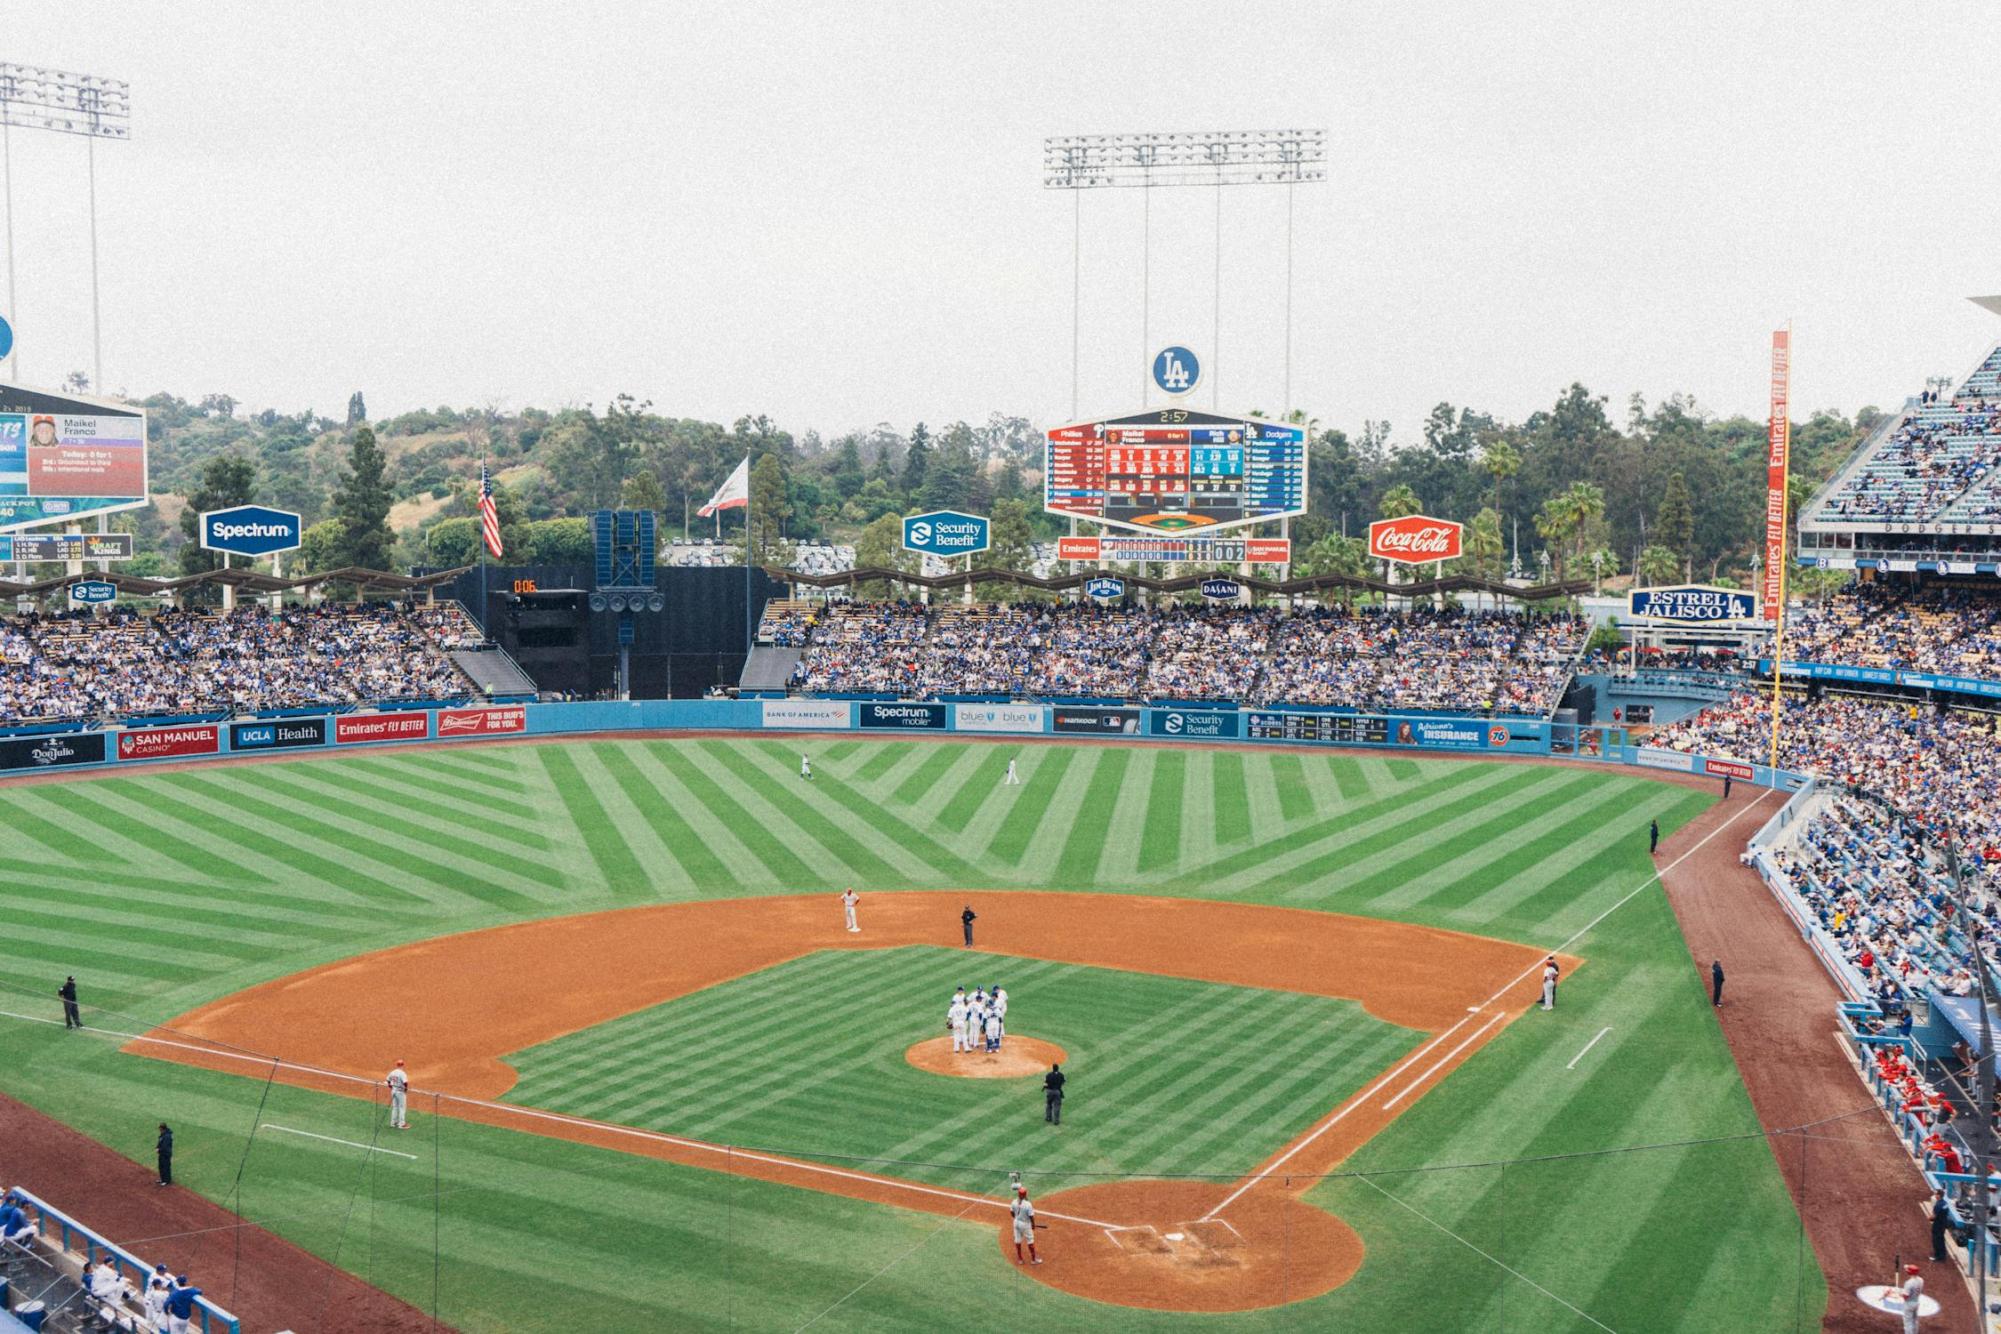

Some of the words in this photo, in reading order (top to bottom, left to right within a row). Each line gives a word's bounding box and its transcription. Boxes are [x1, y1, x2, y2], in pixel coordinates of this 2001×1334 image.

[1164, 352, 1188, 387] LA
[1161, 411, 1188, 422] 2:57
[64, 419, 96, 427] Maikel
[64, 428, 96, 436] Franco
[1266, 431, 1292, 439] Dodgers
[1768, 489, 1782, 522] BETTER
[213, 522, 288, 540] Spectrum
[936, 522, 981, 536] Security
[1768, 524, 1781, 540] FLY
[936, 535, 974, 546] Benefit
[1376, 527, 1453, 552] Coca-Cola
[1237, 547, 1244, 560] 2
[1765, 545, 1780, 607] Emirates
[1089, 582, 1101, 593] JIM
[1102, 580, 1121, 593] BEAM
[1203, 584, 1237, 594] DASANI
[1639, 604, 1722, 618] JALISCO
[487, 712, 502, 720] THIS
[797, 711, 830, 719] AMERICA
[874, 705, 928, 719] Spectrum
[960, 711, 985, 721] blue
[1003, 712, 1027, 722] blue
[487, 721, 500, 729] FOR
[902, 718, 928, 726] mobile
[1186, 714, 1224, 727] Security
[340, 724, 385, 735] Emirates
[388, 721, 399, 732] FLY
[401, 720, 424, 731] BETTER
[1186, 725, 1219, 735] Benefit
[1418, 722, 1453, 732] Adriana's
[136, 735, 161, 745] SAN
[164, 730, 214, 743] MANUEL
[243, 731, 271, 741] UCLA
[278, 726, 318, 741] Health
[1424, 730, 1479, 741] INSURANCE
[1491, 730, 1506, 741] 76
[32, 749, 52, 760] Don
[51, 748, 74, 760] Julio
[136, 745, 168, 753] CASINO
